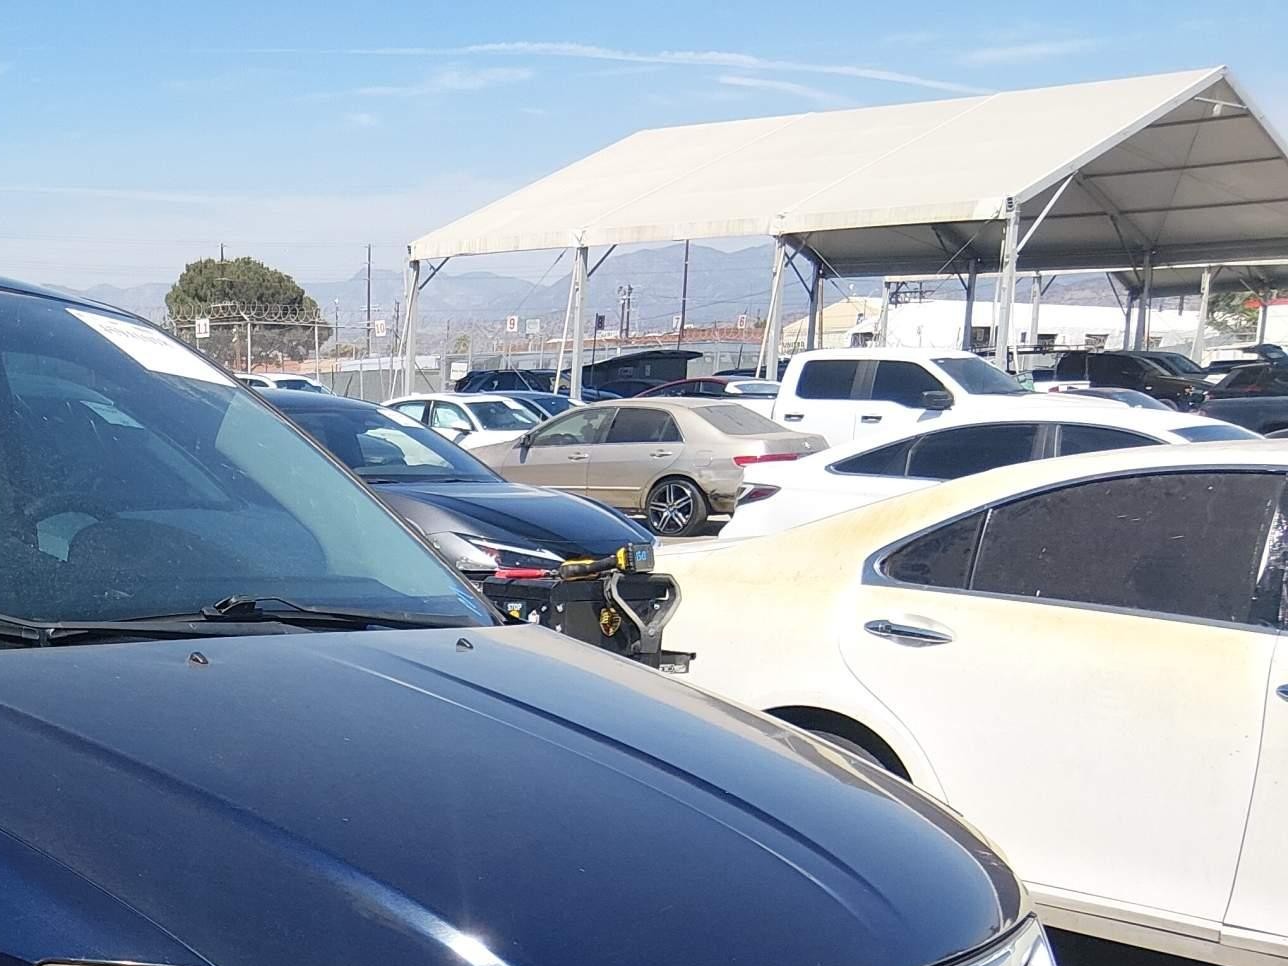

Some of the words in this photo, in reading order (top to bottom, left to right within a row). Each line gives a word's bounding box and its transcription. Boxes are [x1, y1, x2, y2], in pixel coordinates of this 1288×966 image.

[509, 318, 515, 330] 9
[739, 316, 745, 327] 6
[196, 322, 209, 335] 11
[376, 322, 385, 334] 10
